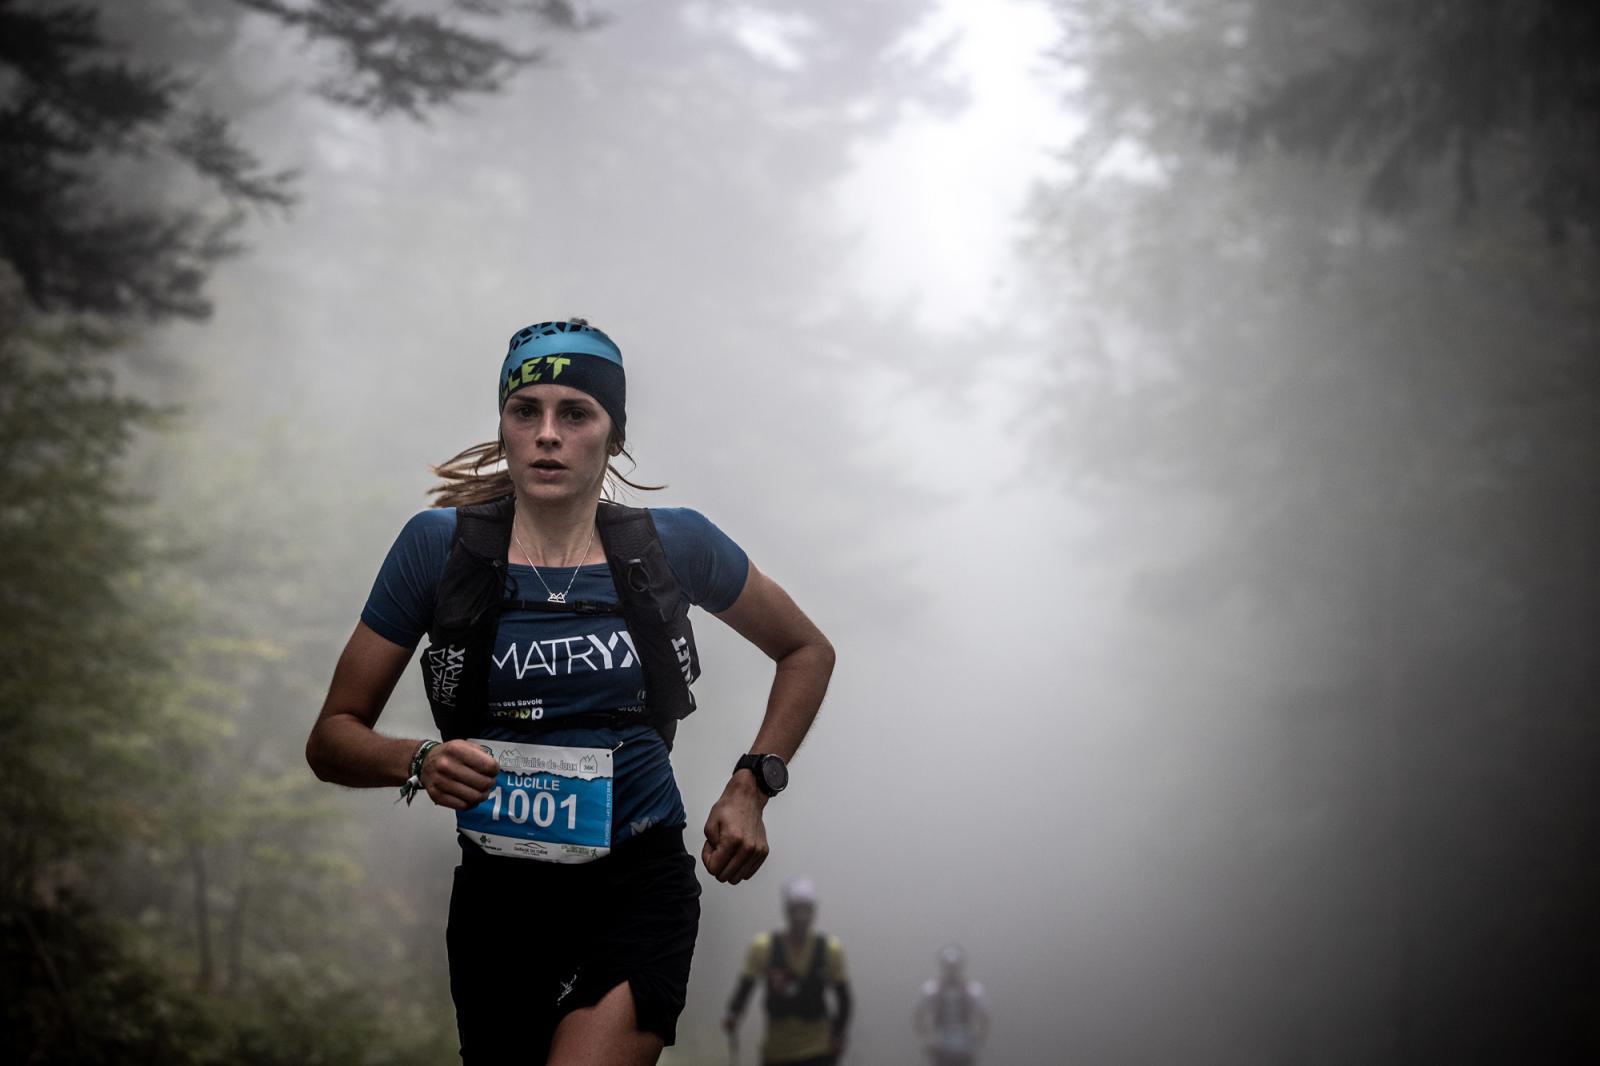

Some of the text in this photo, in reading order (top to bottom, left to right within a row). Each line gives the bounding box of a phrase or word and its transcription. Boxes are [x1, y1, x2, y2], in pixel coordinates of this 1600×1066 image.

[441, 645, 466, 707] MATRYX
[492, 630, 642, 680] MATRYX
[507, 775, 560, 791] LUCILLE
[488, 786, 577, 830] 1001
